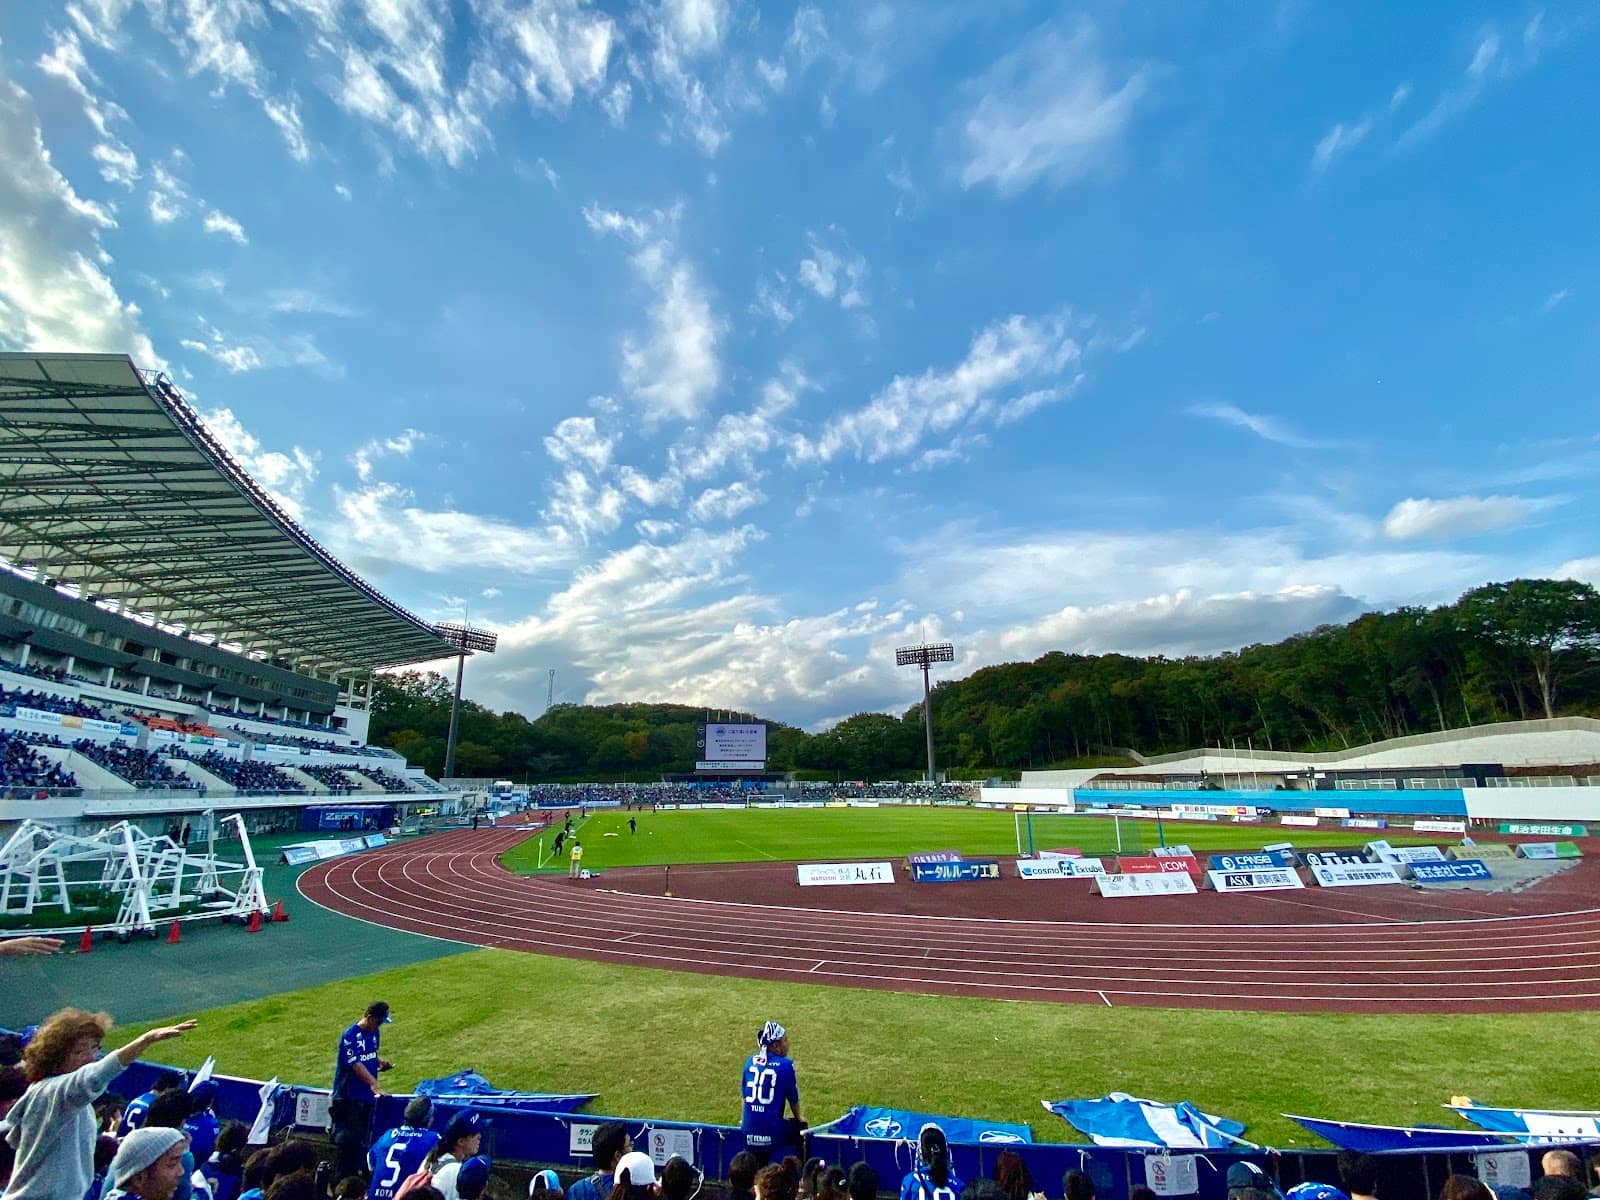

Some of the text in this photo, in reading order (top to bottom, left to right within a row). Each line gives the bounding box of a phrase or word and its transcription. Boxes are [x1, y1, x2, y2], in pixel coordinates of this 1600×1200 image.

[1509, 824, 1572, 835] 明治安田生命
[1032, 867, 1060, 875] cosmo
[1414, 863, 1488, 879] 株式会社ヒコネ
[1229, 875, 1251, 887] ASK
[745, 1065, 777, 1105] 30
[751, 1104, 765, 1113] YUKI
[380, 1142, 407, 1187] 5
[374, 1188, 393, 1198] KOTA
